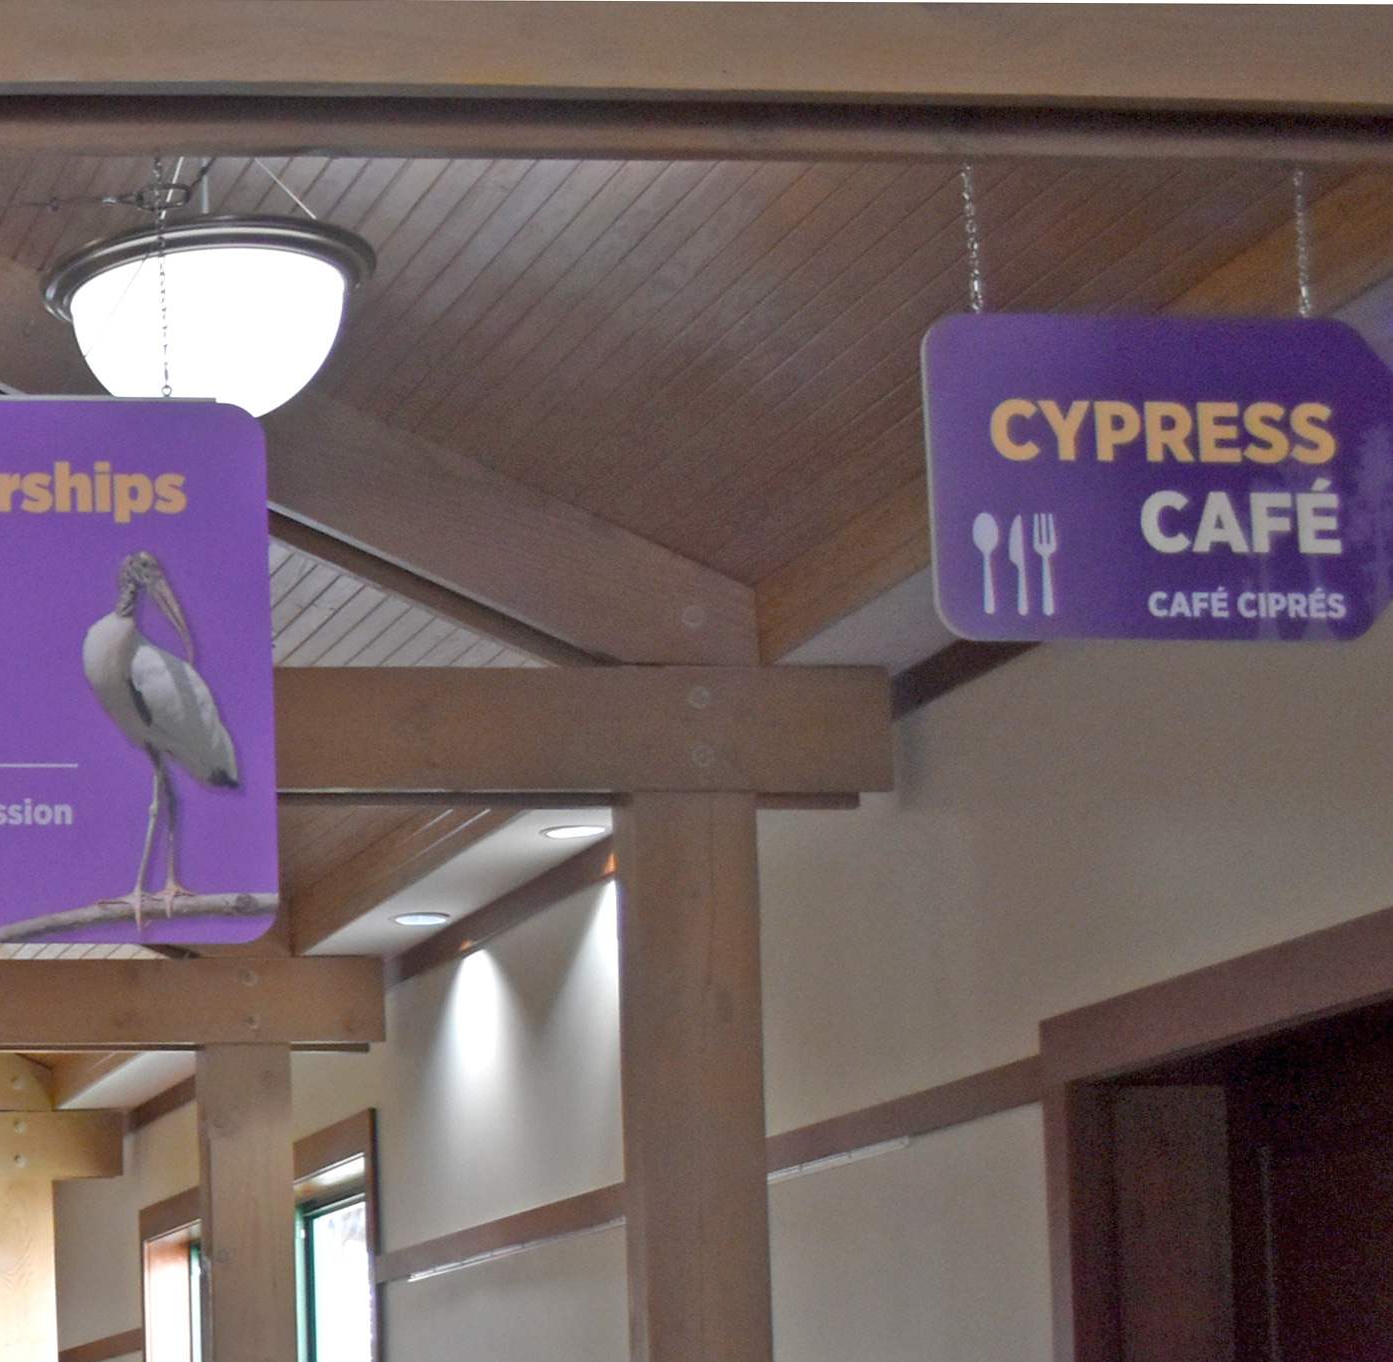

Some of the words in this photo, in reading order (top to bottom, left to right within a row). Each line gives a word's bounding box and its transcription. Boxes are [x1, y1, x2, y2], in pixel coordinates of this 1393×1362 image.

[990, 398, 1337, 464] CYPRESS
[1140, 478, 1342, 555] CAFÉ
[1148, 586, 1229, 618] CAFÉ
[1237, 587, 1347, 619] CIPRÉS
